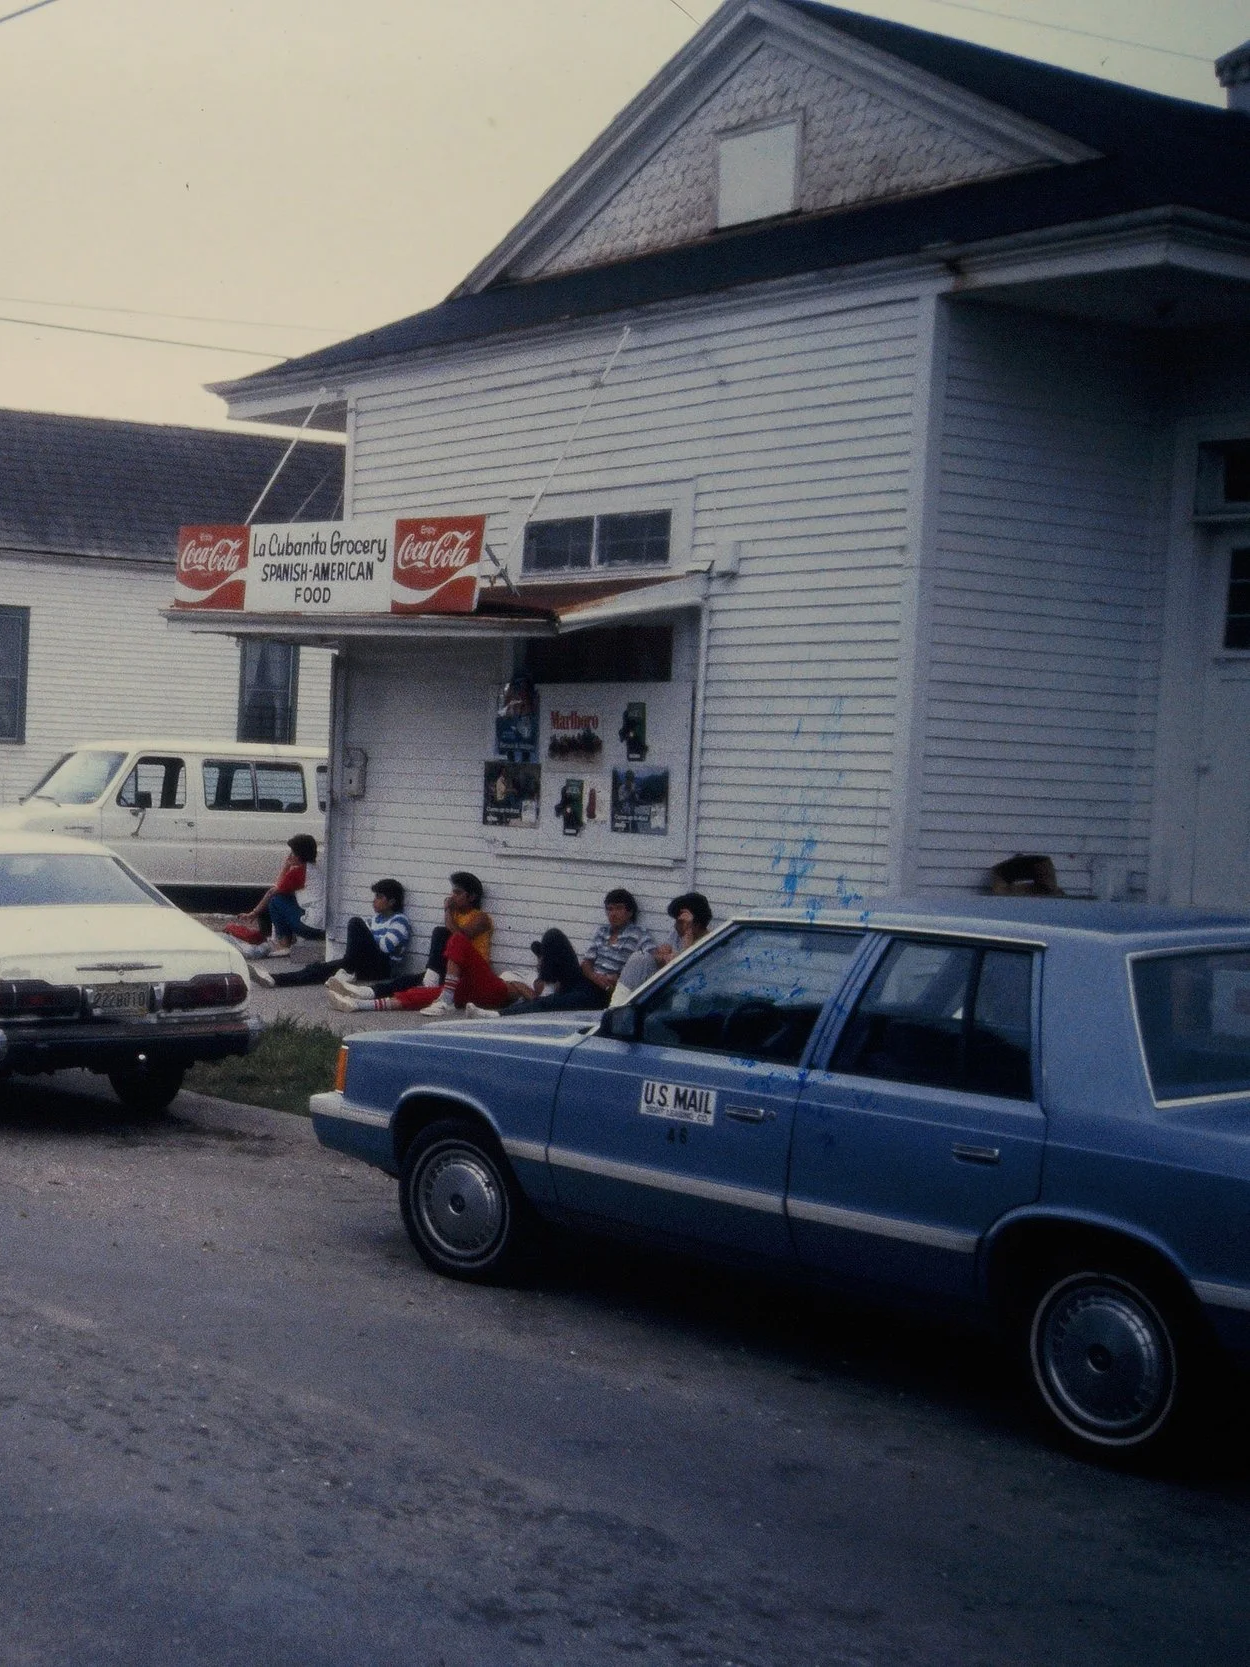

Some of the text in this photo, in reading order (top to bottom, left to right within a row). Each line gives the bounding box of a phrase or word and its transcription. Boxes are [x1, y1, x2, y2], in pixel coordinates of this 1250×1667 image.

[253, 530, 387, 563] La Cubanita Grocery
[261, 562, 374, 583] SPANISH-AMERICAN
[294, 587, 331, 603] FOOD
[551, 711, 599, 730] Marlboro
[673, 1087, 712, 1115] MAIL
